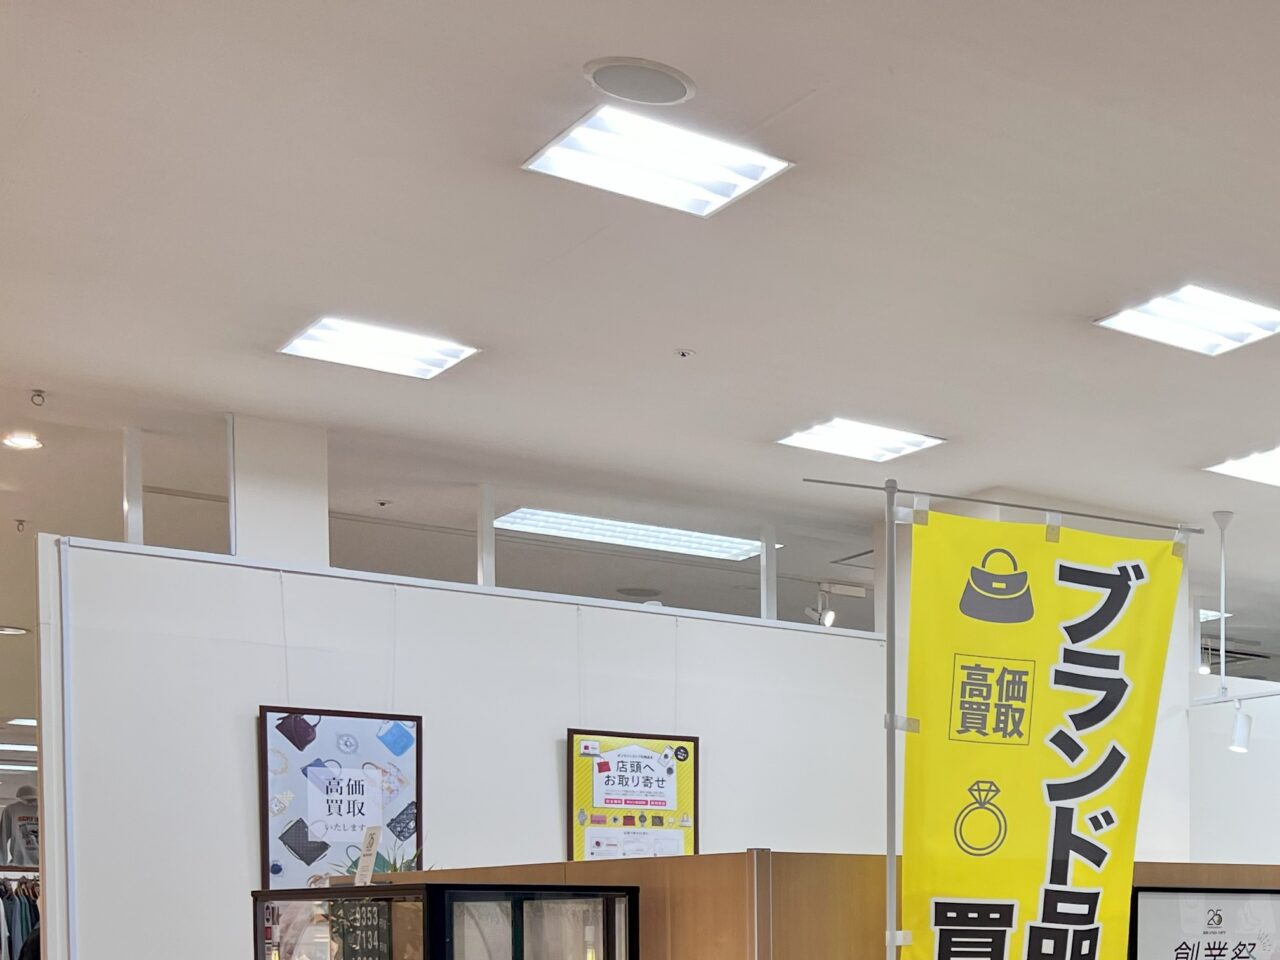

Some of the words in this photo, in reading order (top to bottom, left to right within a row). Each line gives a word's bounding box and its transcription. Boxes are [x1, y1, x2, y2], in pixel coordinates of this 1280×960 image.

[960, 663, 1029, 704] 高価
[956, 701, 1024, 739] 買取
[616, 760, 655, 774] 店頭へ
[325, 777, 365, 796] 高価
[604, 774, 666, 788] お取り寄せ
[326, 798, 366, 817] 買取
[324, 823, 366, 832] いたします
